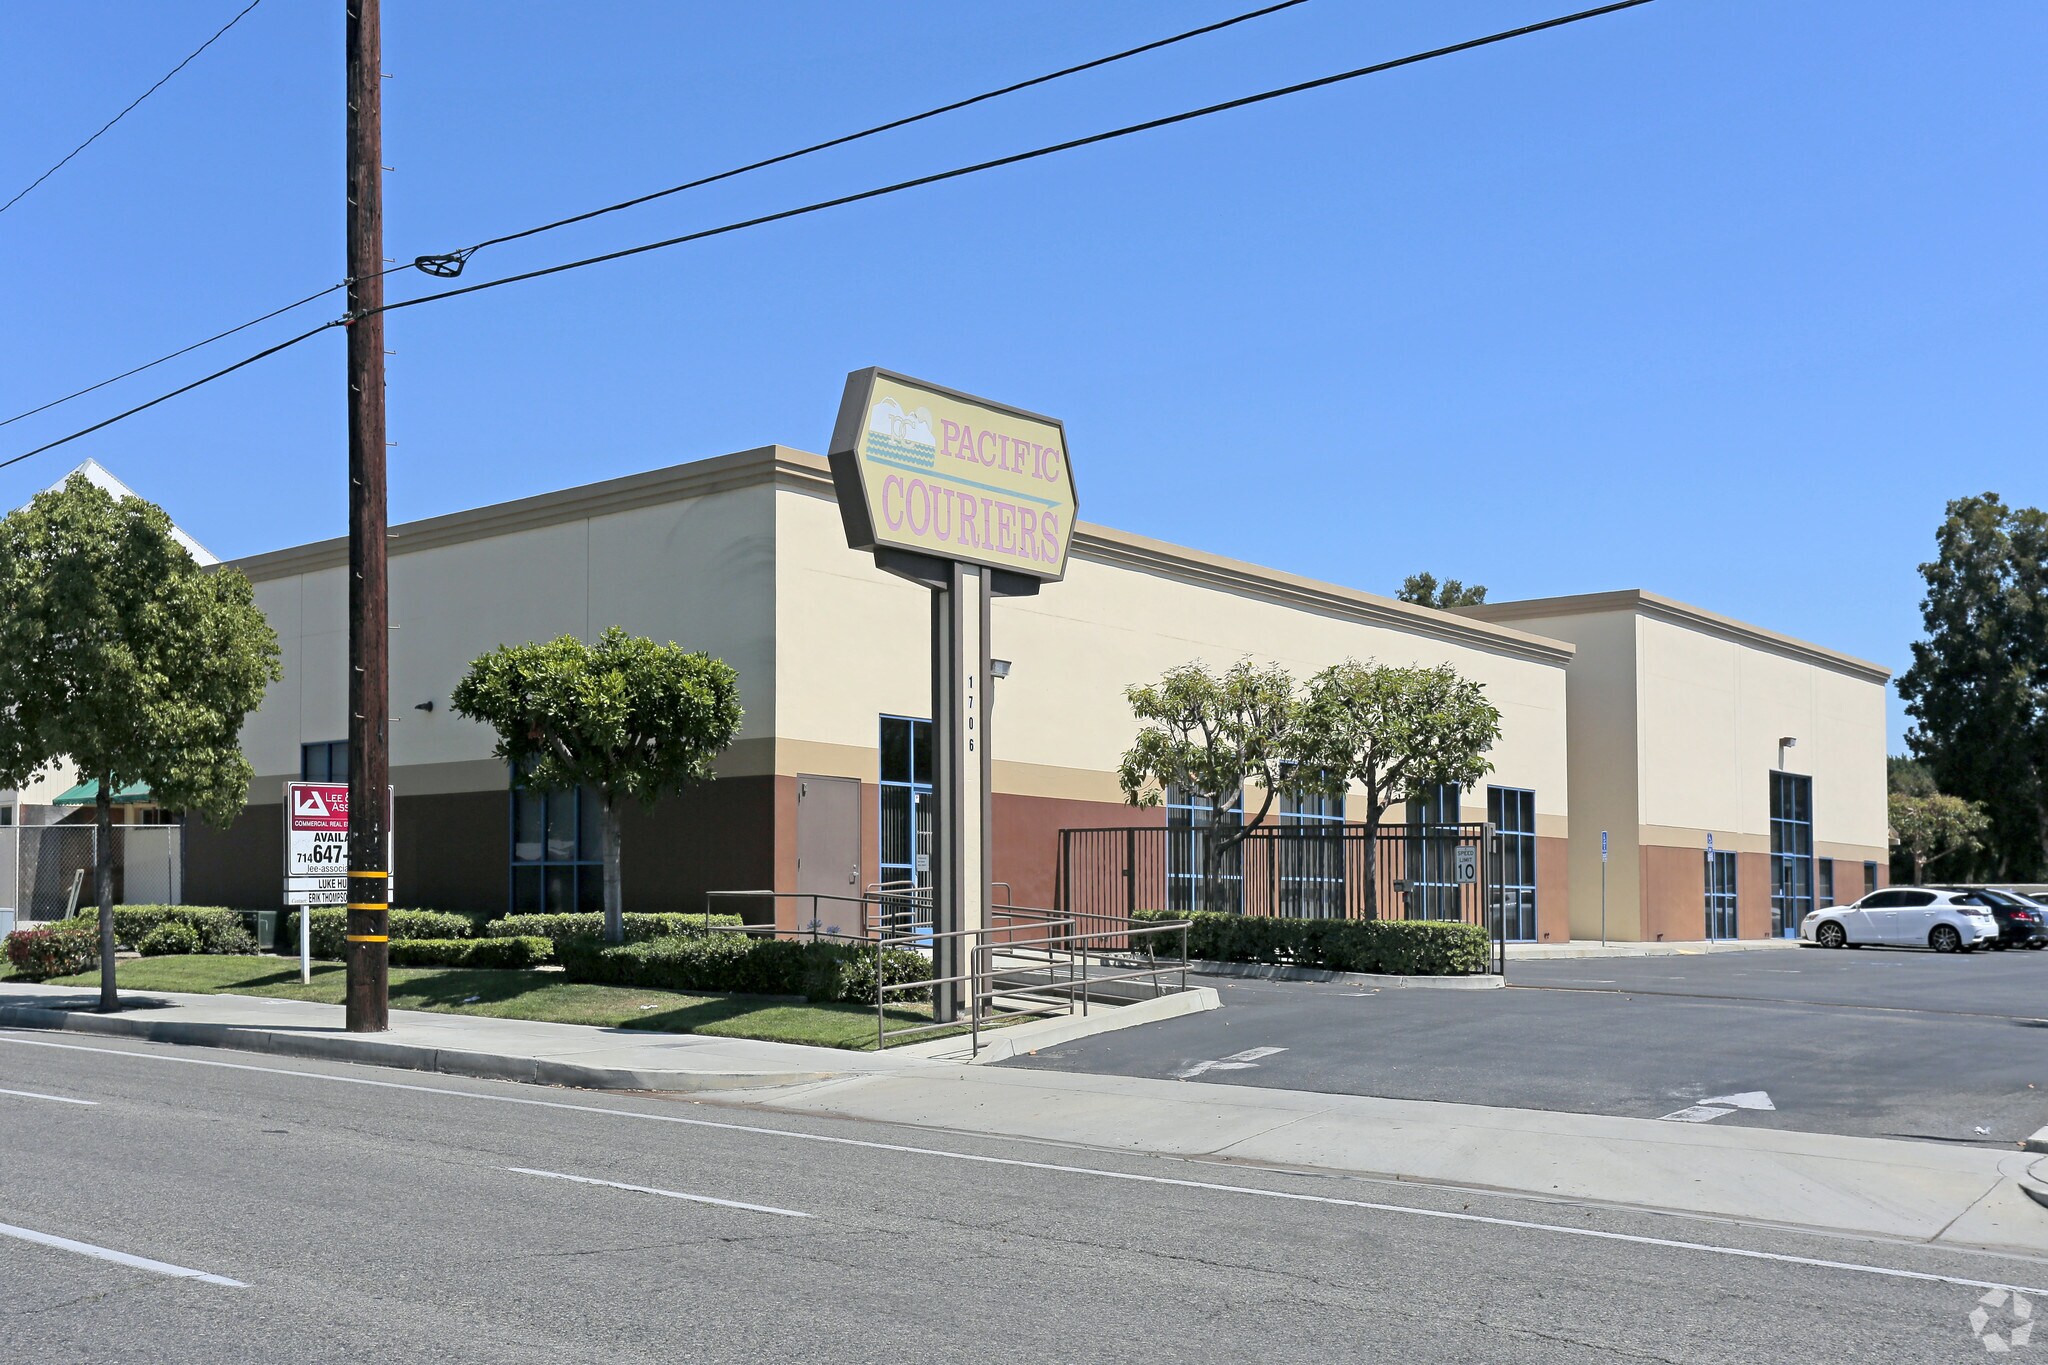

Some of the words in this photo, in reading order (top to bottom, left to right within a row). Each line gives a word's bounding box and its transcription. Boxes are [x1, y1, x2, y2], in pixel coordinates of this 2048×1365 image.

[940, 418, 1060, 482] PACIFIC
[882, 474, 1059, 564] COURIERS
[325, 792, 343, 802] LEE
[1458, 864, 1474, 879] 10
[318, 879, 336, 889] LUKE
[308, 892, 321, 903] ERIK
